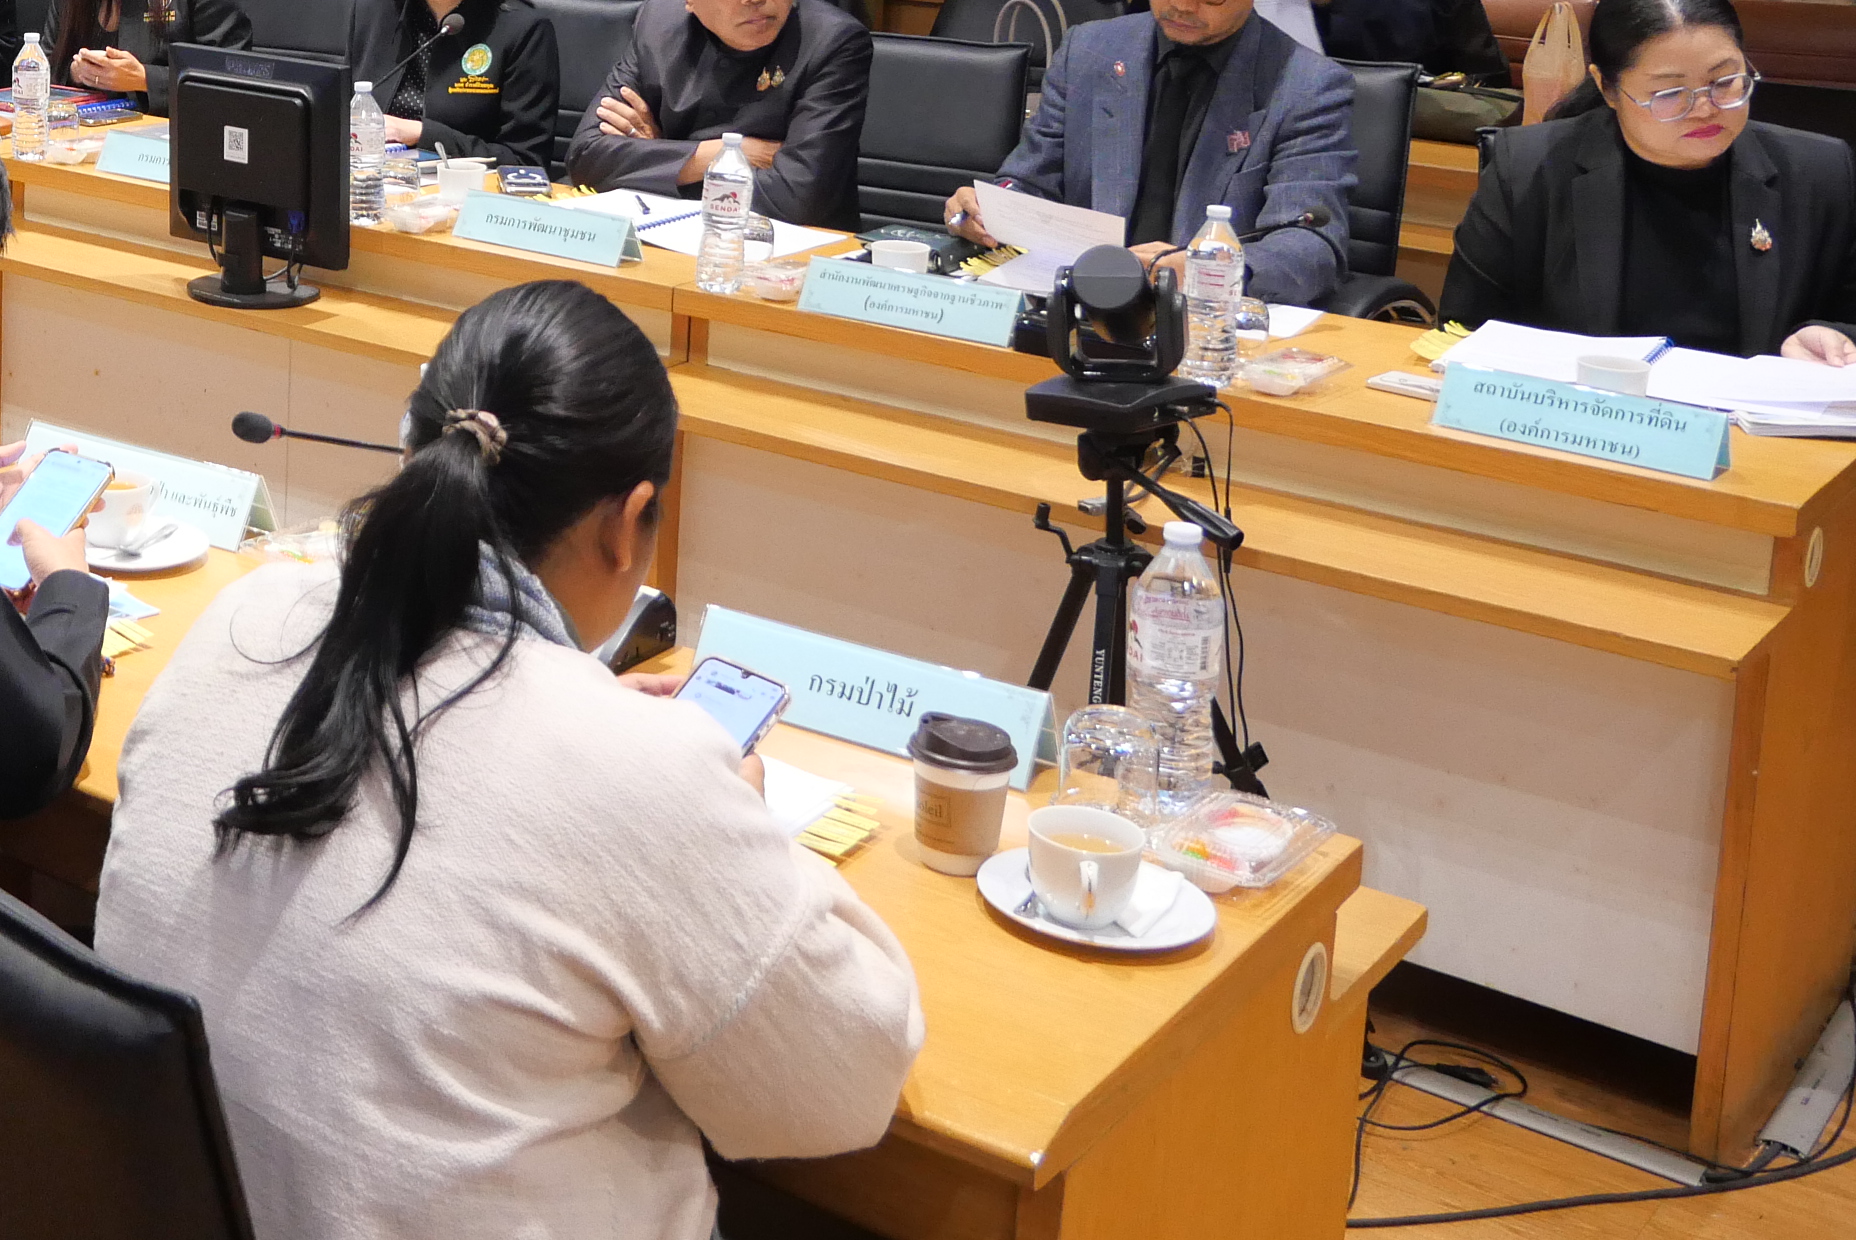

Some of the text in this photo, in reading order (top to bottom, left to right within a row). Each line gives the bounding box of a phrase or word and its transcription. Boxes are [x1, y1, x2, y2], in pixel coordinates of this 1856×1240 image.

[485, 213, 597, 242] กรมการพัฒนาชุมชน
[863, 295, 944, 324] (องค์การมหาชน)
[1473, 380, 1687, 433] สถาบันบริหารจัดการที่ดิน
[1499, 417, 1641, 459] (องค์การมหาชน)
[808, 674, 919, 718] กรมป่าไม้
[1091, 649, 1106, 704] YUNTENG
